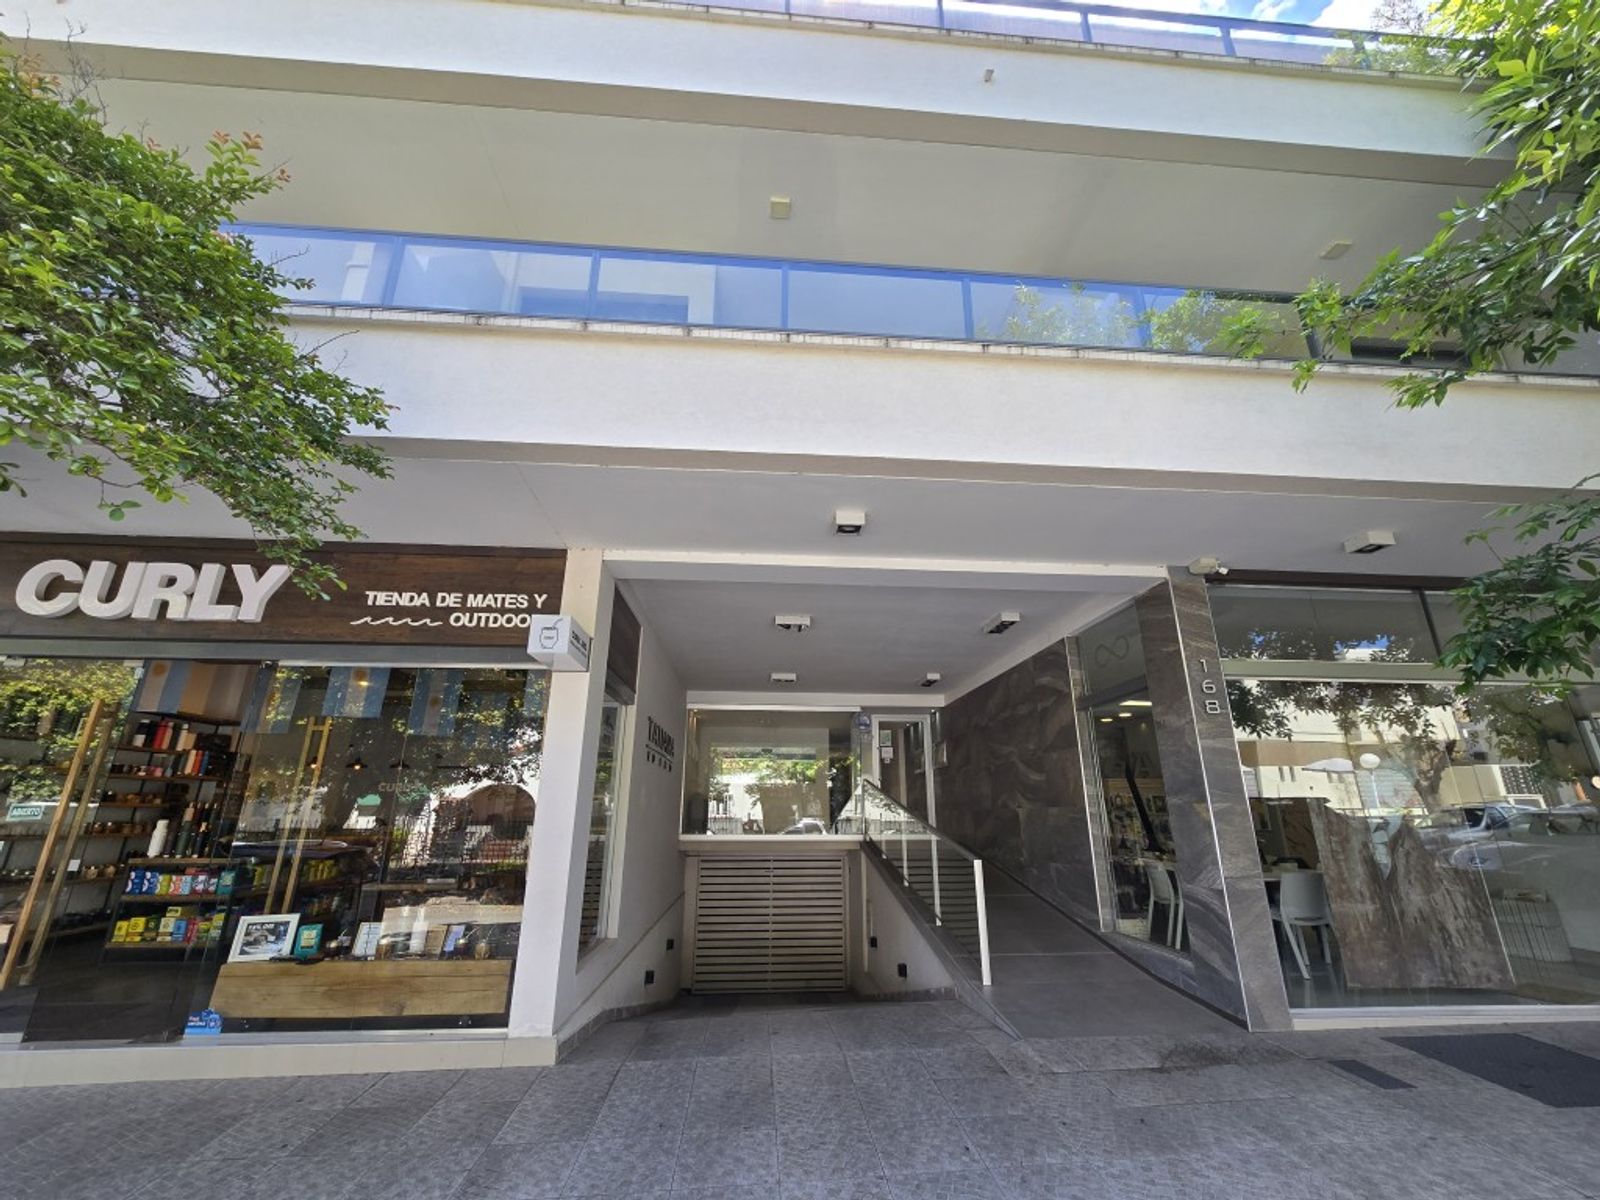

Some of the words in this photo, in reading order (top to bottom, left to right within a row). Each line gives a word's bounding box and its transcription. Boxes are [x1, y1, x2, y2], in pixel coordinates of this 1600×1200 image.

[15, 559, 294, 623] CURLY
[365, 591, 430, 607] TIENDA
[435, 592, 463, 608] DE
[466, 593, 529, 609] MATES
[533, 593, 548, 609] Y
[449, 612, 532, 628] OUTDOO
